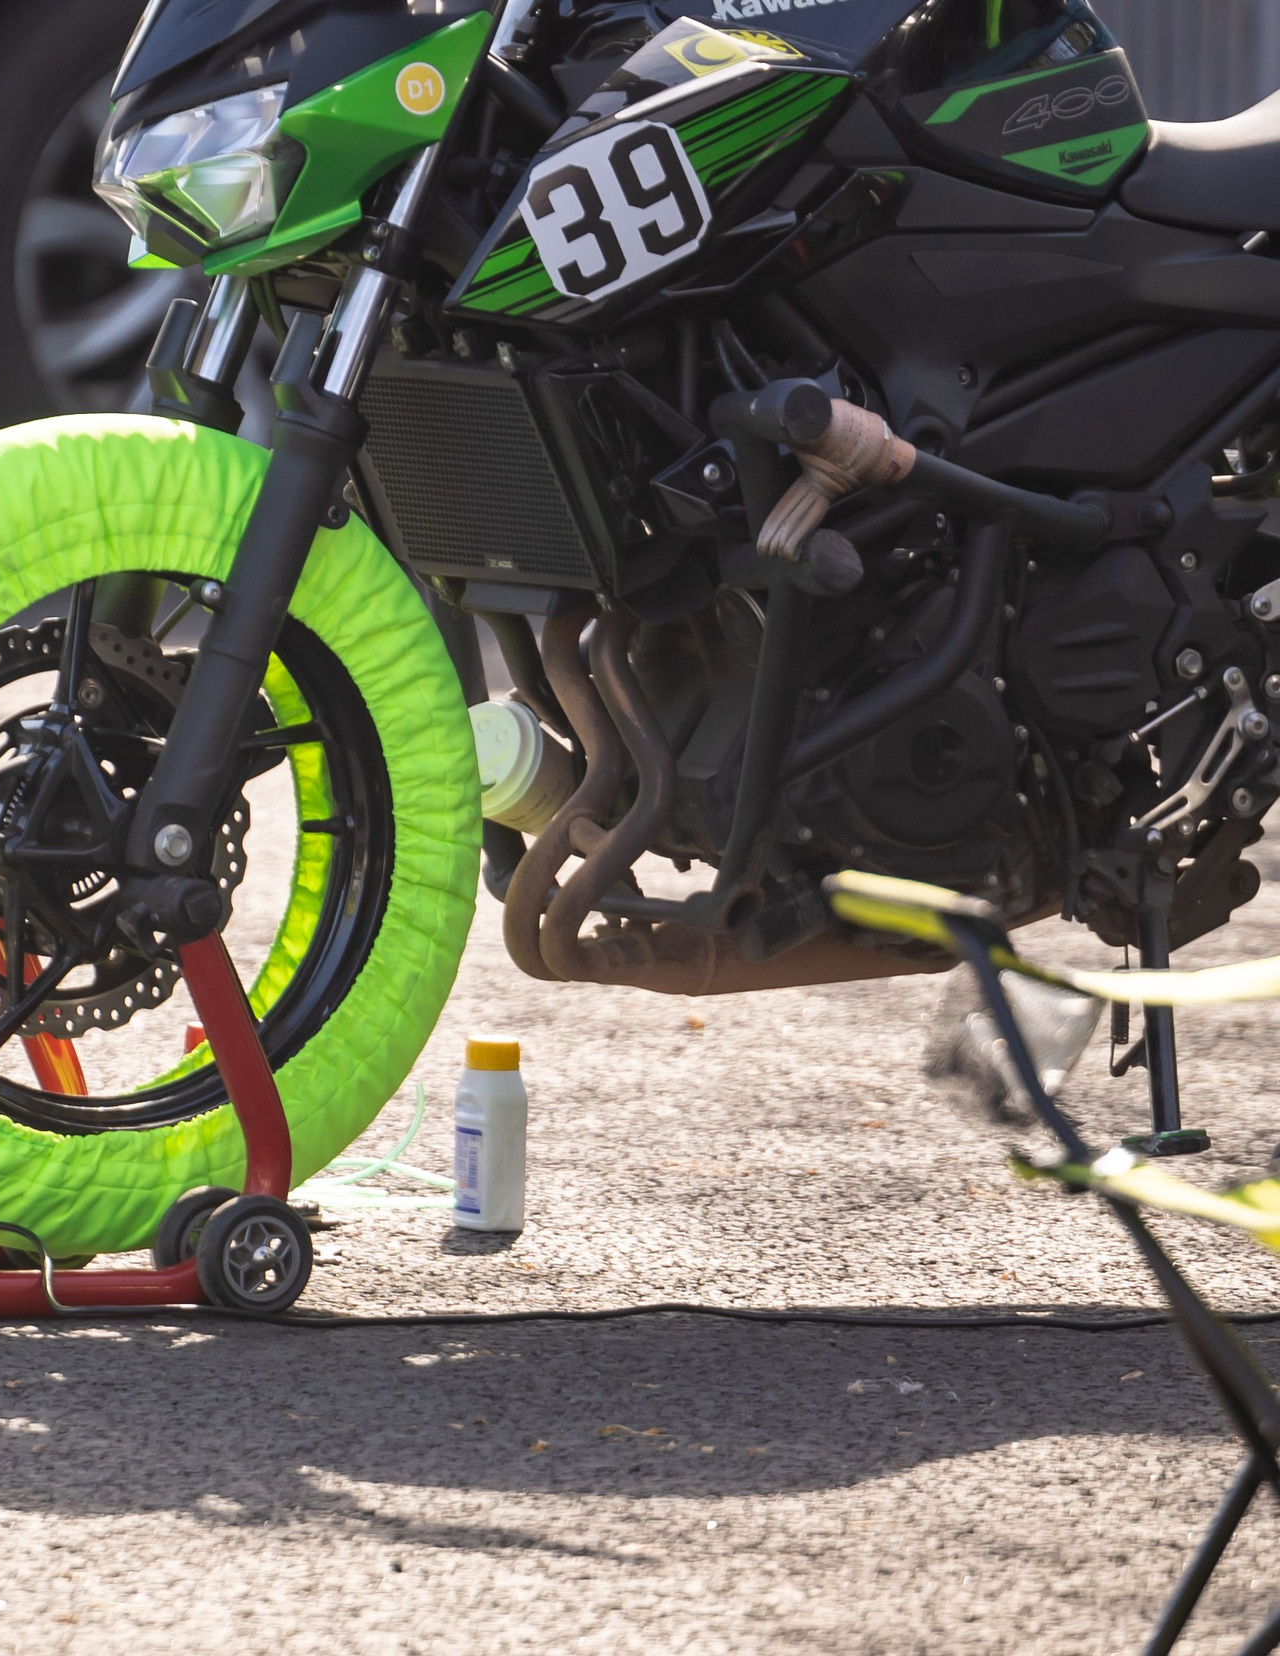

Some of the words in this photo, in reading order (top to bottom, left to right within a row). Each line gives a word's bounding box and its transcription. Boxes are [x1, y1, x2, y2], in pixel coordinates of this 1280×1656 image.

[406, 78, 434, 100] D1
[1002, 74, 1129, 135] 400
[1058, 139, 1112, 165] Kawasaki
[526, 124, 705, 297] 39
